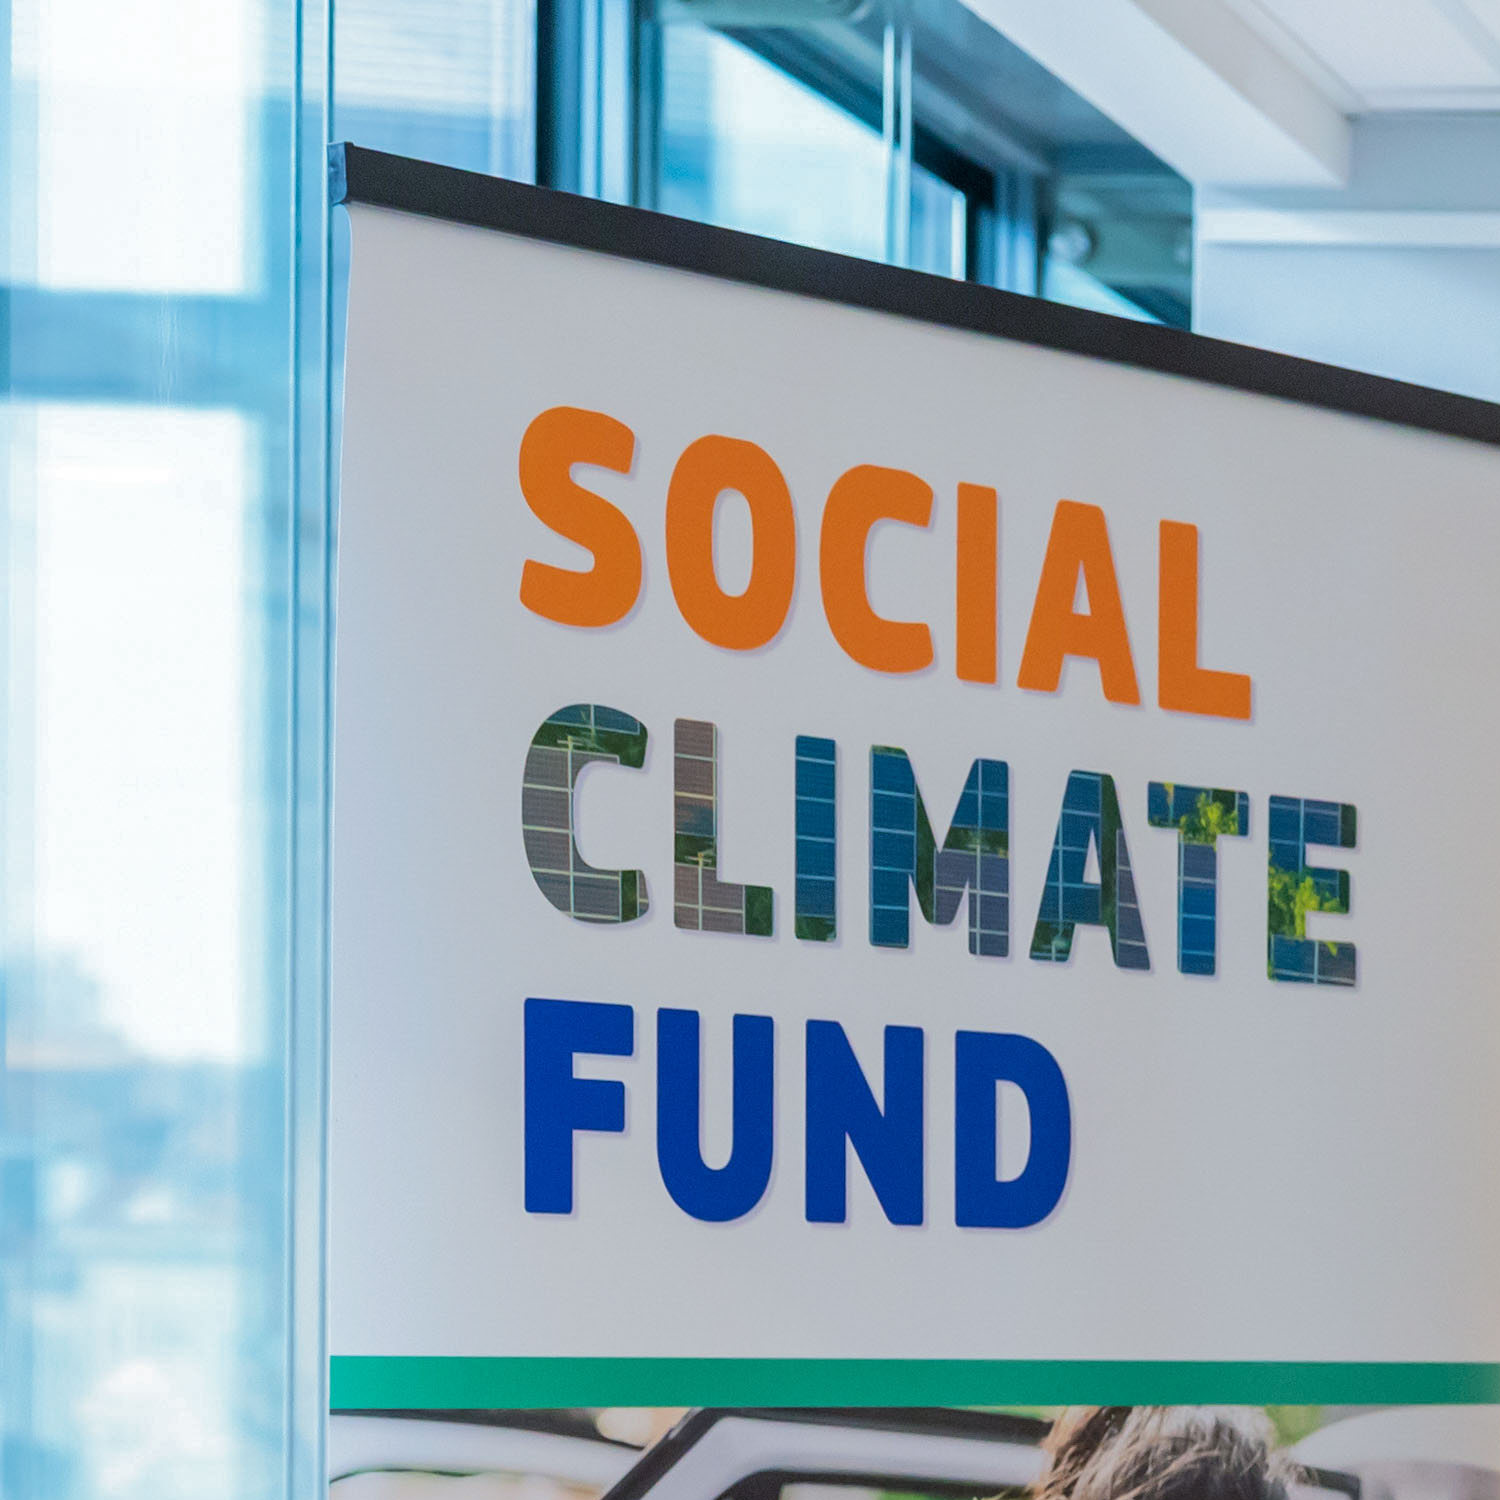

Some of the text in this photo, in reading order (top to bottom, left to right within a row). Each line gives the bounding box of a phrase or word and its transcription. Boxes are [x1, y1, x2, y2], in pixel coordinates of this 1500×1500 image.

[518, 405, 1253, 721] SOCIAL
[521, 703, 1358, 988] CLIMATE
[523, 997, 1072, 1229] FUND
